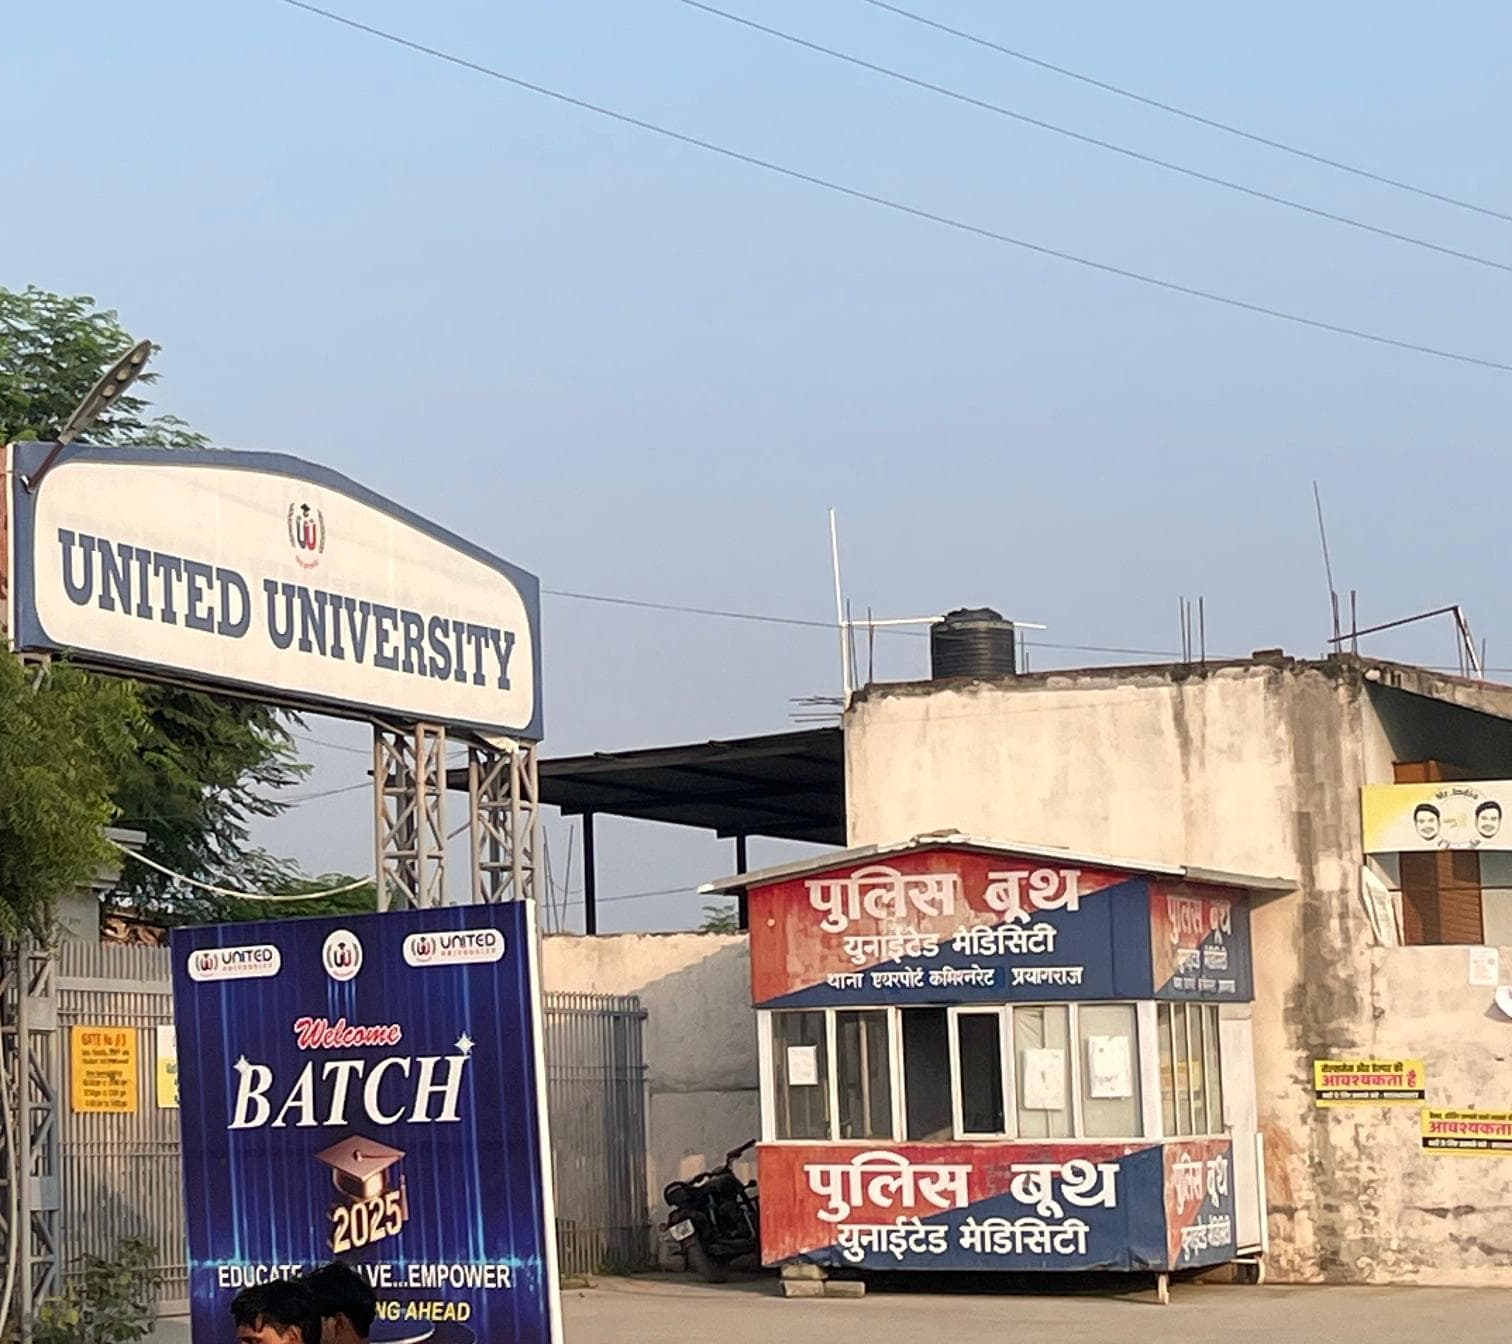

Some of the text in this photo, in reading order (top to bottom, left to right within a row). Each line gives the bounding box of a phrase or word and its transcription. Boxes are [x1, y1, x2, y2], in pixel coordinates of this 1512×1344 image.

[58, 528, 515, 691] UNITED UNIVERSITY
[804, 865, 1081, 933] पुलिस बूथ
[221, 948, 273, 965] UNITED
[439, 932, 496, 949] UNITED
[826, 972, 864, 989] थाना
[870, 966, 925, 989] एयरपोर्ट
[1011, 967, 1083, 986] प्रयागराज
[294, 1017, 402, 1050] Welcome
[227, 1056, 471, 1130] BATCH
[1322, 1069, 1416, 1087] आवश्यकता है
[804, 1151, 1120, 1222] पुलिस बूथ
[333, 1190, 402, 1254] 2025
[959, 1216, 1090, 1254] मेडिसिटी
[404, 1301, 471, 1322] AHEAD
